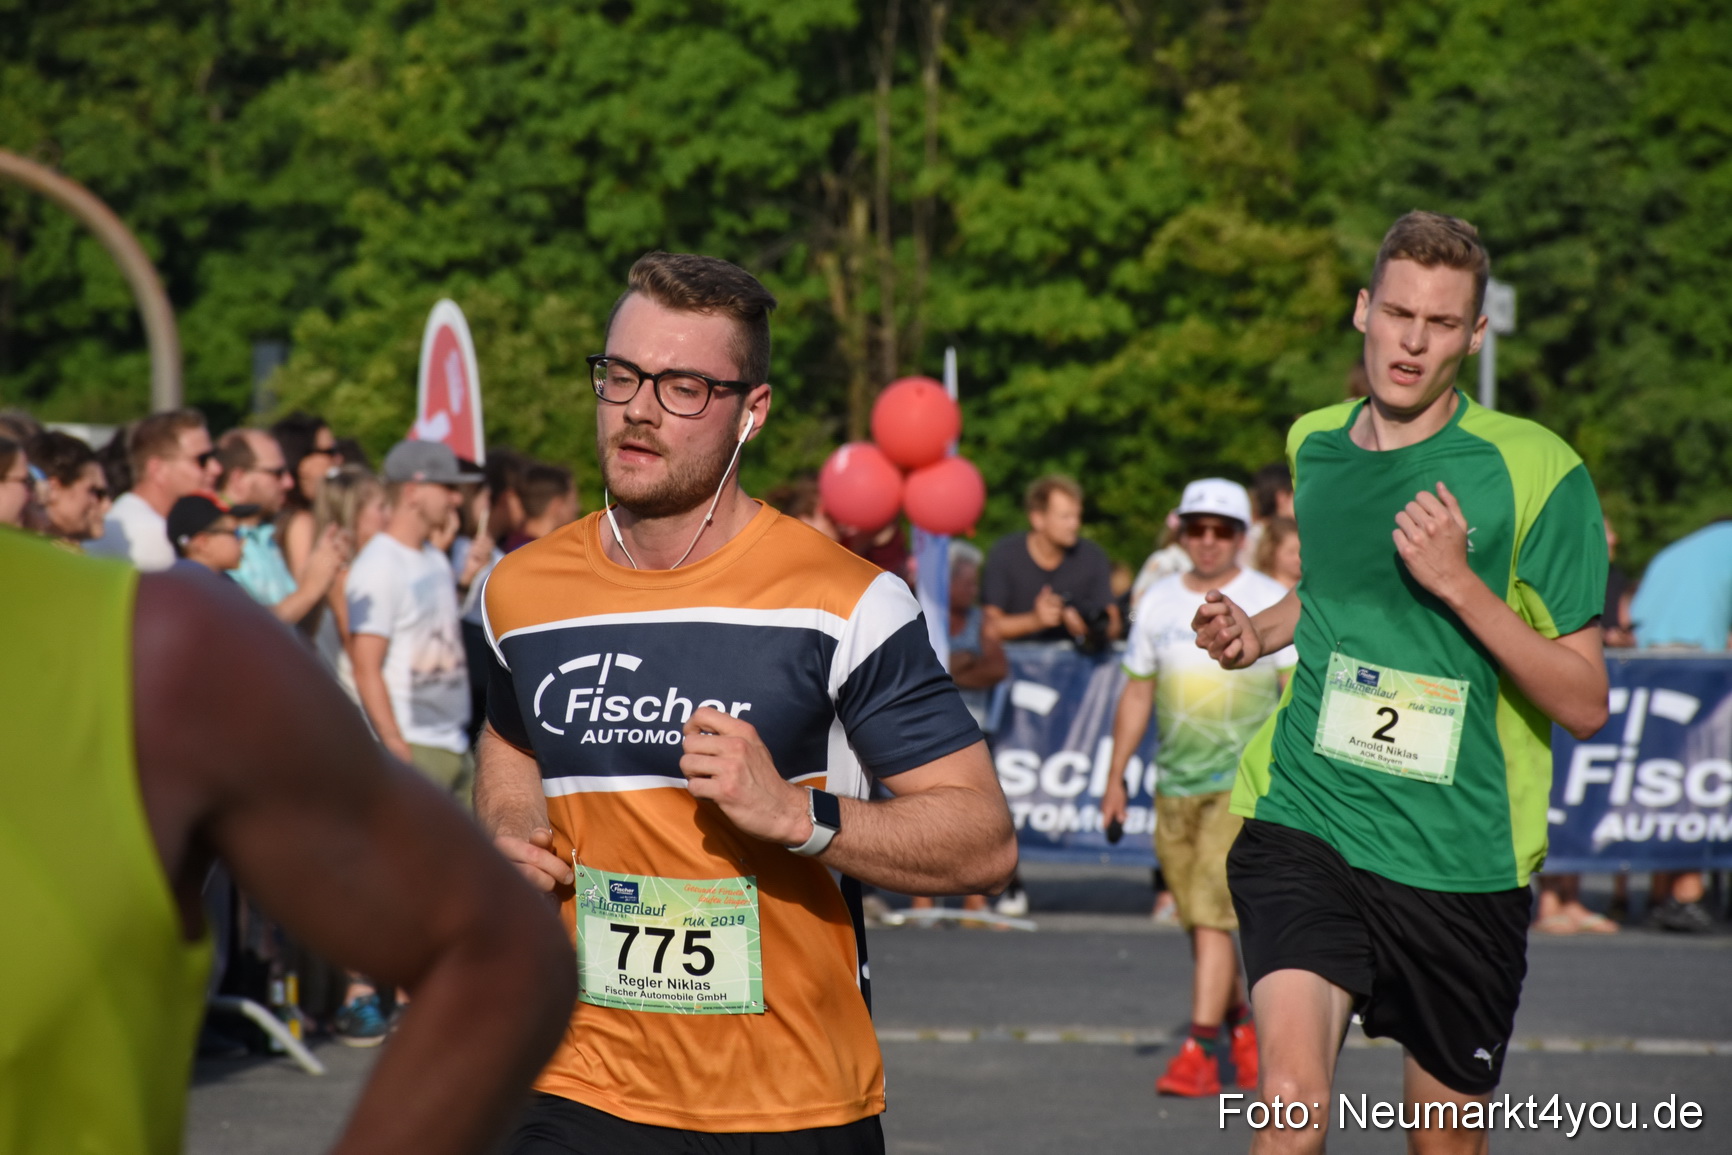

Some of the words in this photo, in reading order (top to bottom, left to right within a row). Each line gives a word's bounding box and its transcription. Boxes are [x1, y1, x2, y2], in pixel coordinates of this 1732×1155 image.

[1345, 678, 1398, 700] firmenlauf
[1429, 705, 1455, 717] 2019
[1372, 706, 1399, 744] 2
[581, 728, 686, 745] AUTOMO
[1348, 736, 1383, 752] Arnold
[1386, 745, 1419, 760] Niklas
[1360, 750, 1376, 759] AOK
[1377, 754, 1403, 765] Bayern
[599, 896, 667, 917] firmenlauf
[710, 914, 745, 927] 2019
[610, 923, 715, 977] 775
[618, 973, 663, 990] Regler
[667, 977, 711, 991] Niklas
[605, 985, 637, 998] Fischer
[640, 989, 694, 1002] Automobile
[696, 992, 728, 1002] GmbH
